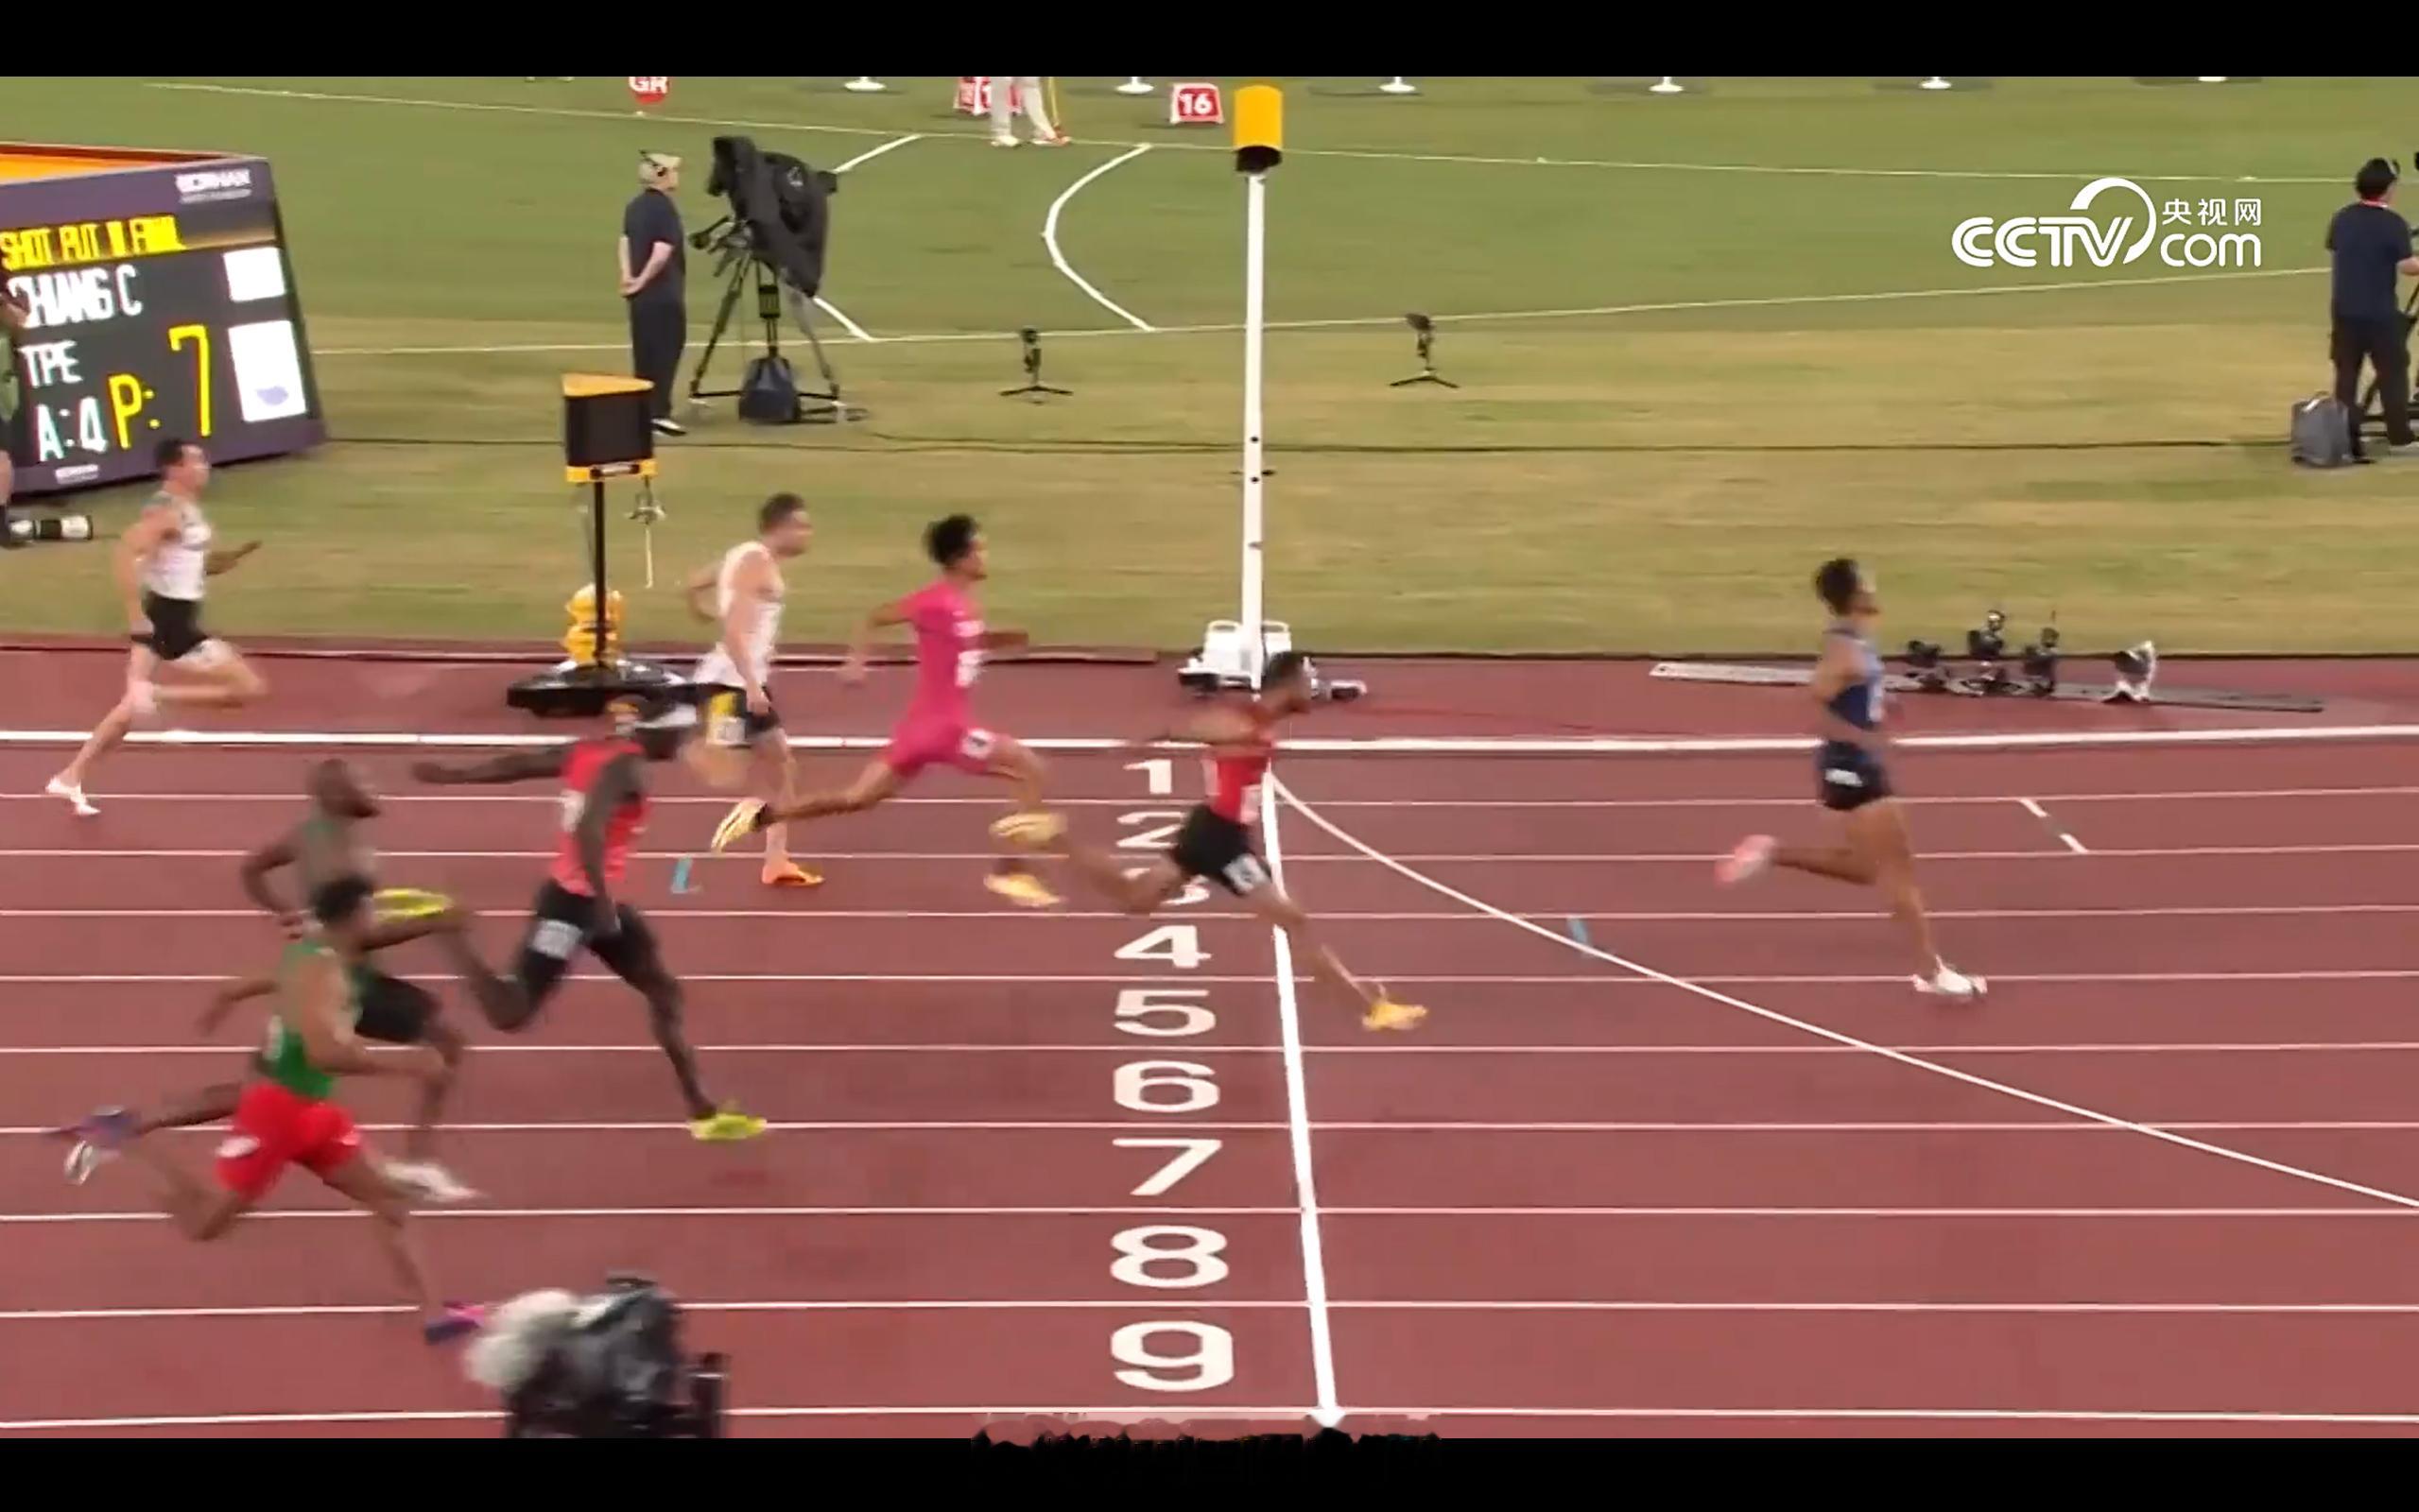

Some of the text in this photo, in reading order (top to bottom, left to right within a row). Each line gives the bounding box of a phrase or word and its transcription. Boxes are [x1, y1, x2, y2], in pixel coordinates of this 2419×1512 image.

[1181, 93, 1213, 114] 16
[59, 223, 100, 262] PUT
[116, 264, 143, 317] C
[19, 340, 82, 388] TPE
[168, 324, 212, 437] 7
[1122, 759, 1172, 795] 1
[1116, 811, 1190, 849] 2
[1114, 924, 1212, 968] 4
[1114, 989, 1217, 1037] 5
[1113, 1060, 1220, 1112] 6
[1112, 1138, 1222, 1195] 7
[1110, 1225, 1229, 1288] 8
[1110, 1320, 1234, 1392] 9
